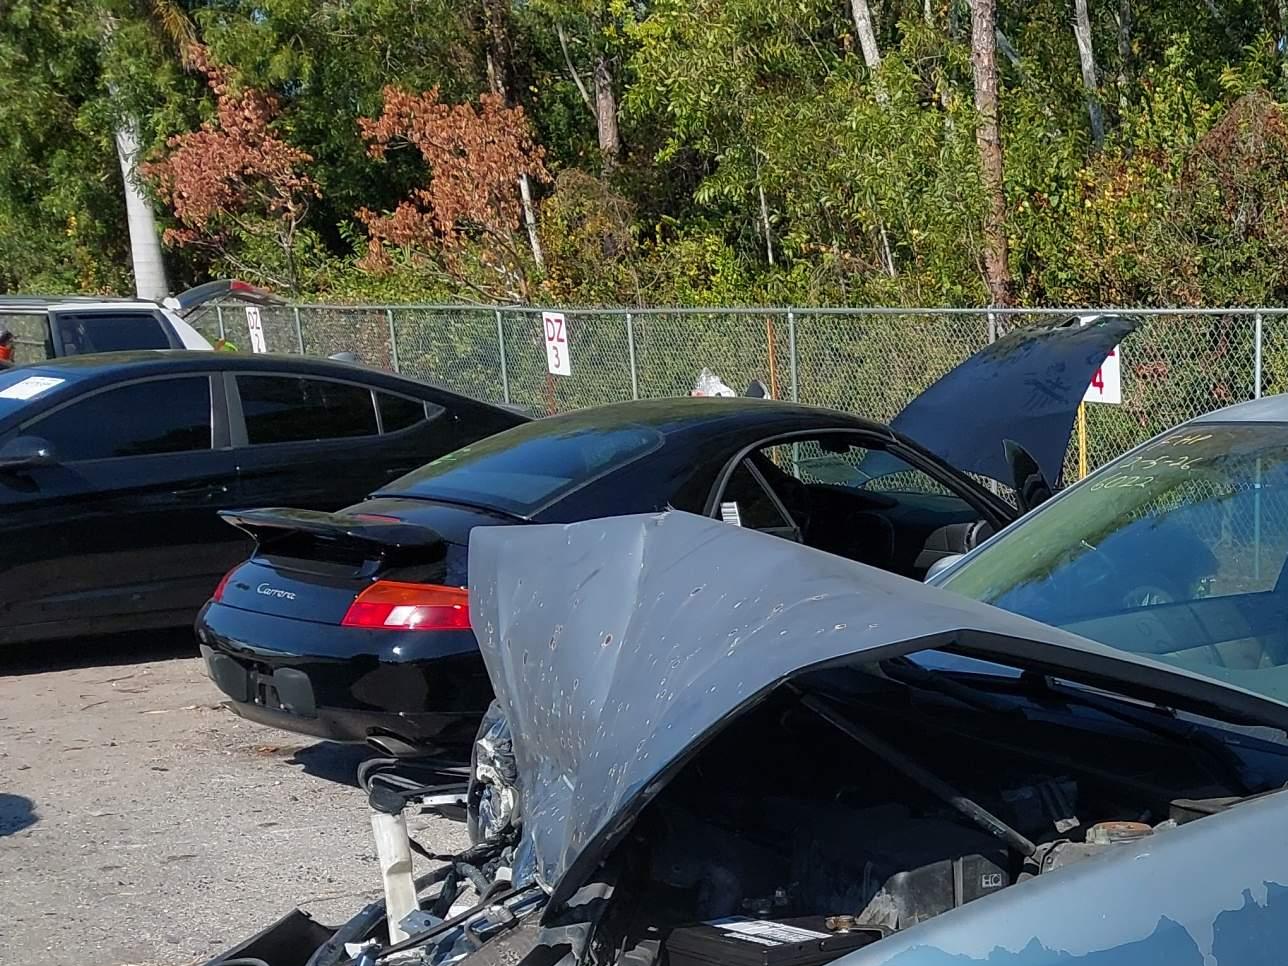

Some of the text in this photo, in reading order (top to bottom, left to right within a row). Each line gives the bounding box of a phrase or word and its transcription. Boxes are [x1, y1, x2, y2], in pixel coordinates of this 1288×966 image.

[545, 318, 565, 342] DZ
[552, 346, 561, 368] 3
[1091, 367, 1104, 394] 4
[256, 583, 297, 600] Carrera
